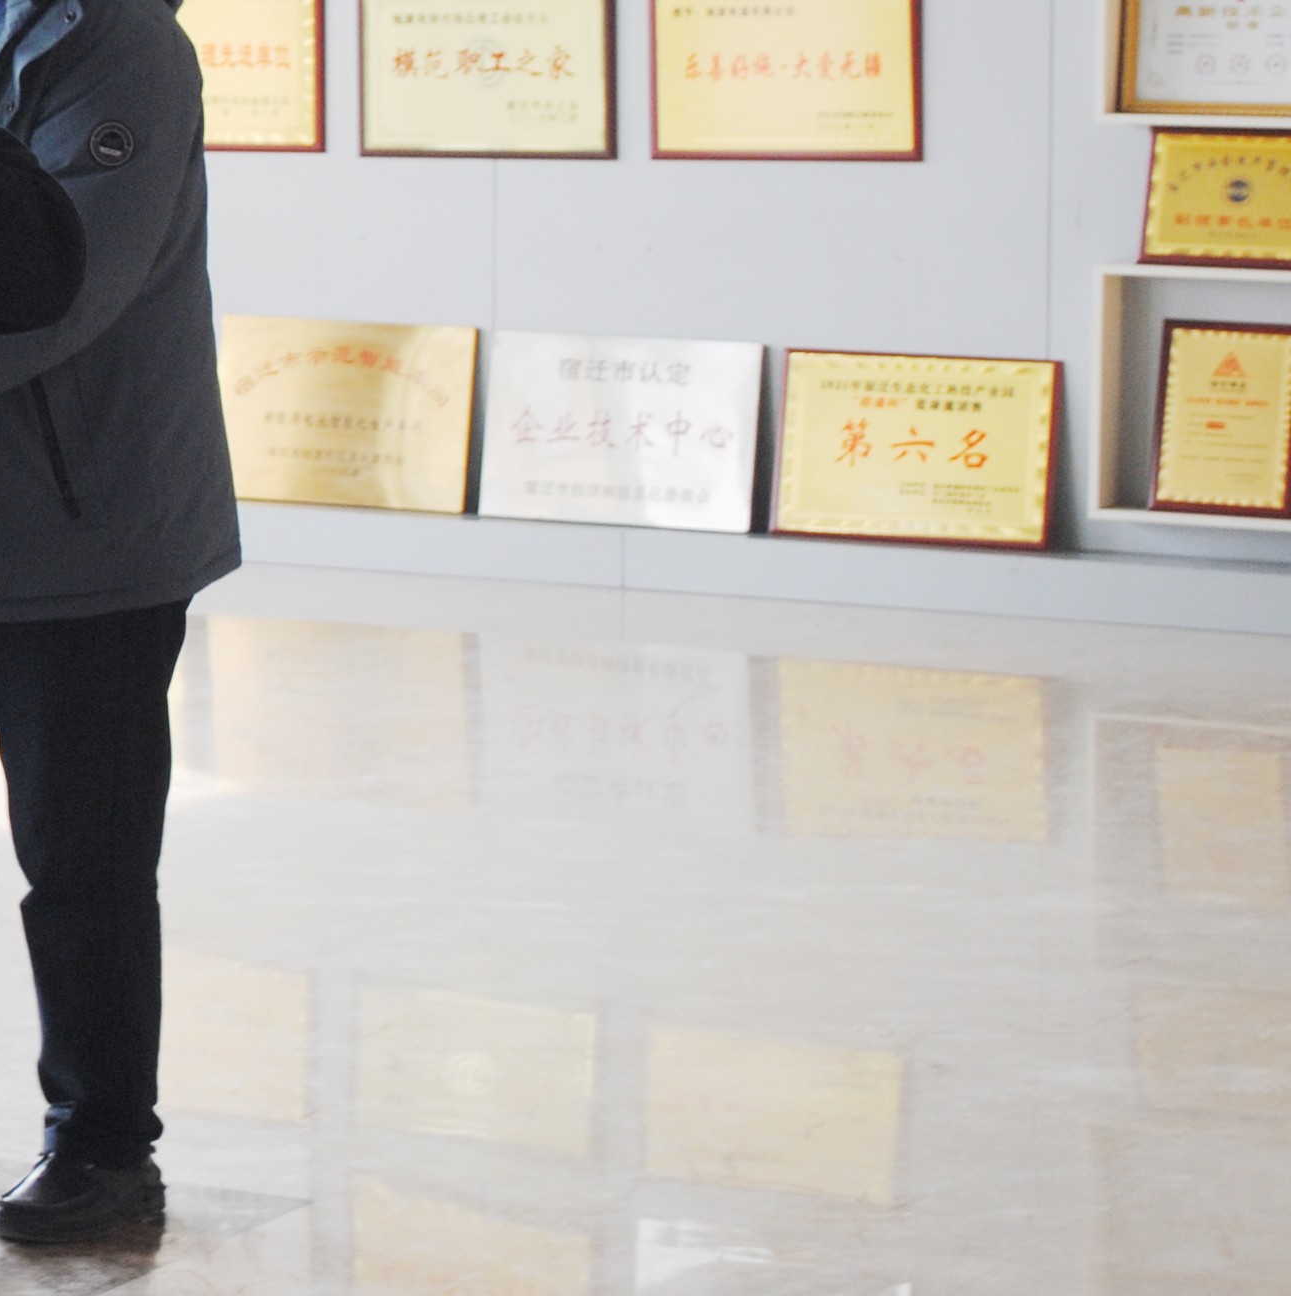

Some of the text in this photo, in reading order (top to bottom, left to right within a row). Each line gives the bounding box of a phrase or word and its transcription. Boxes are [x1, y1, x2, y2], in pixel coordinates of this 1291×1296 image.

[392, 45, 576, 81] 模范职工之家
[558, 357, 692, 386] 宿迁市认定
[510, 406, 735, 457] 企业技术中心
[834, 418, 989, 470] 第六名
